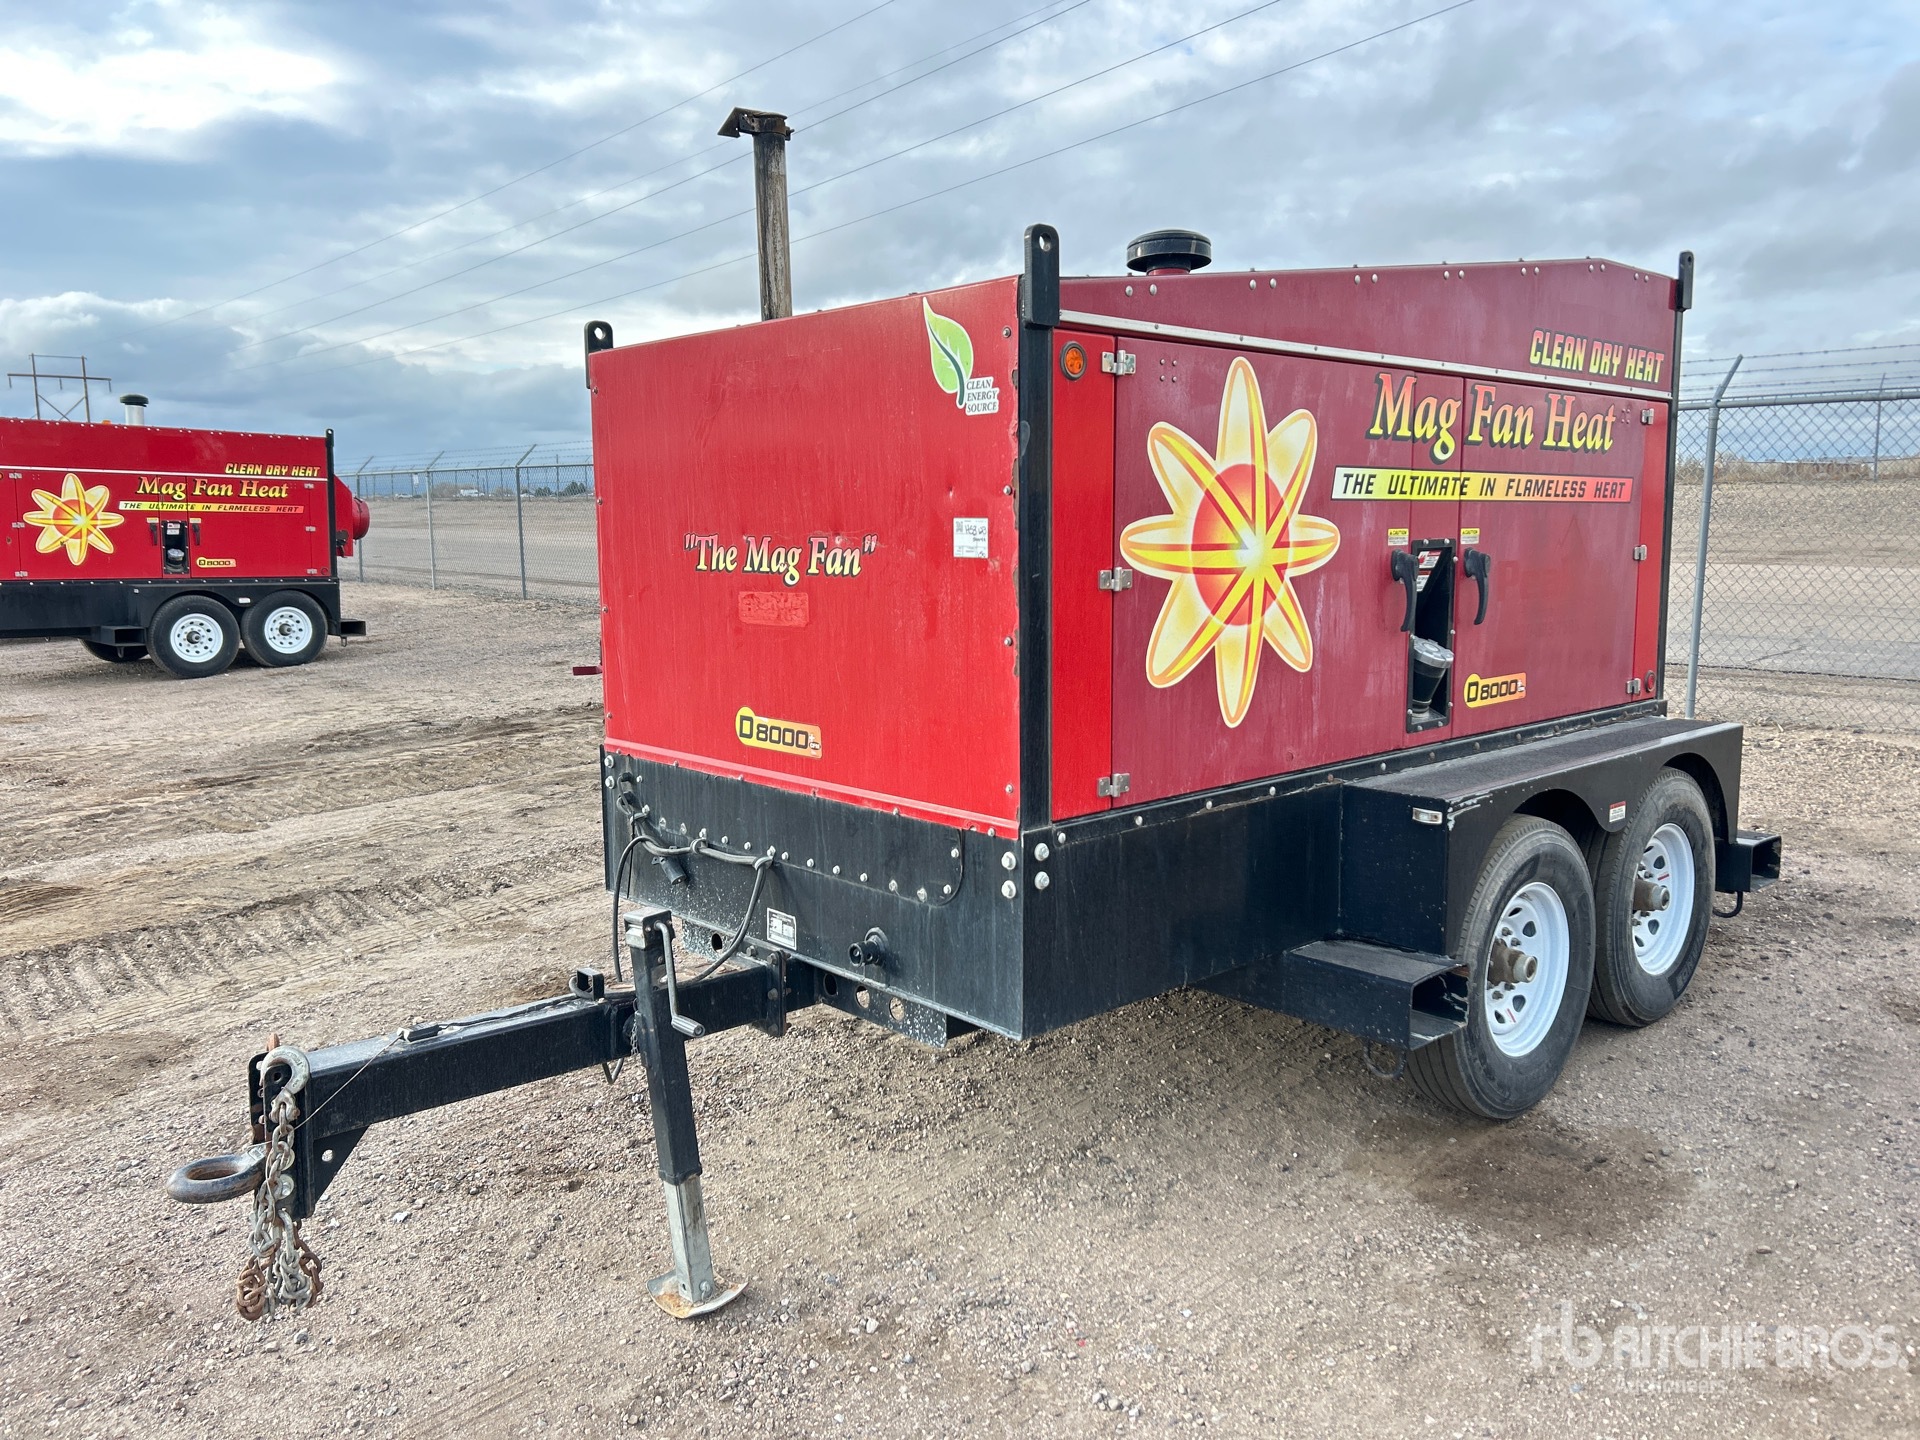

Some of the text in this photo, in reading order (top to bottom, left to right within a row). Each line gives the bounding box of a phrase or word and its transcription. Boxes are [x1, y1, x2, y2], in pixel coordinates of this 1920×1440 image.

[1529, 329, 1664, 383] CLEAN DRY HEAT
[966, 379, 992, 390] CLEAN
[967, 390, 997, 401] ENERGY
[967, 402, 997, 412] SOURCE
[1366, 372, 1617, 465] Mag Fan Heat
[225, 463, 320, 477] CLEAN DRY HEAT
[136, 476, 289, 500] Mag Fan Heat
[1342, 473, 1626, 499] THE ULTIMATE IN FLAMELESS HEAT
[742, 535, 802, 587] Mag
